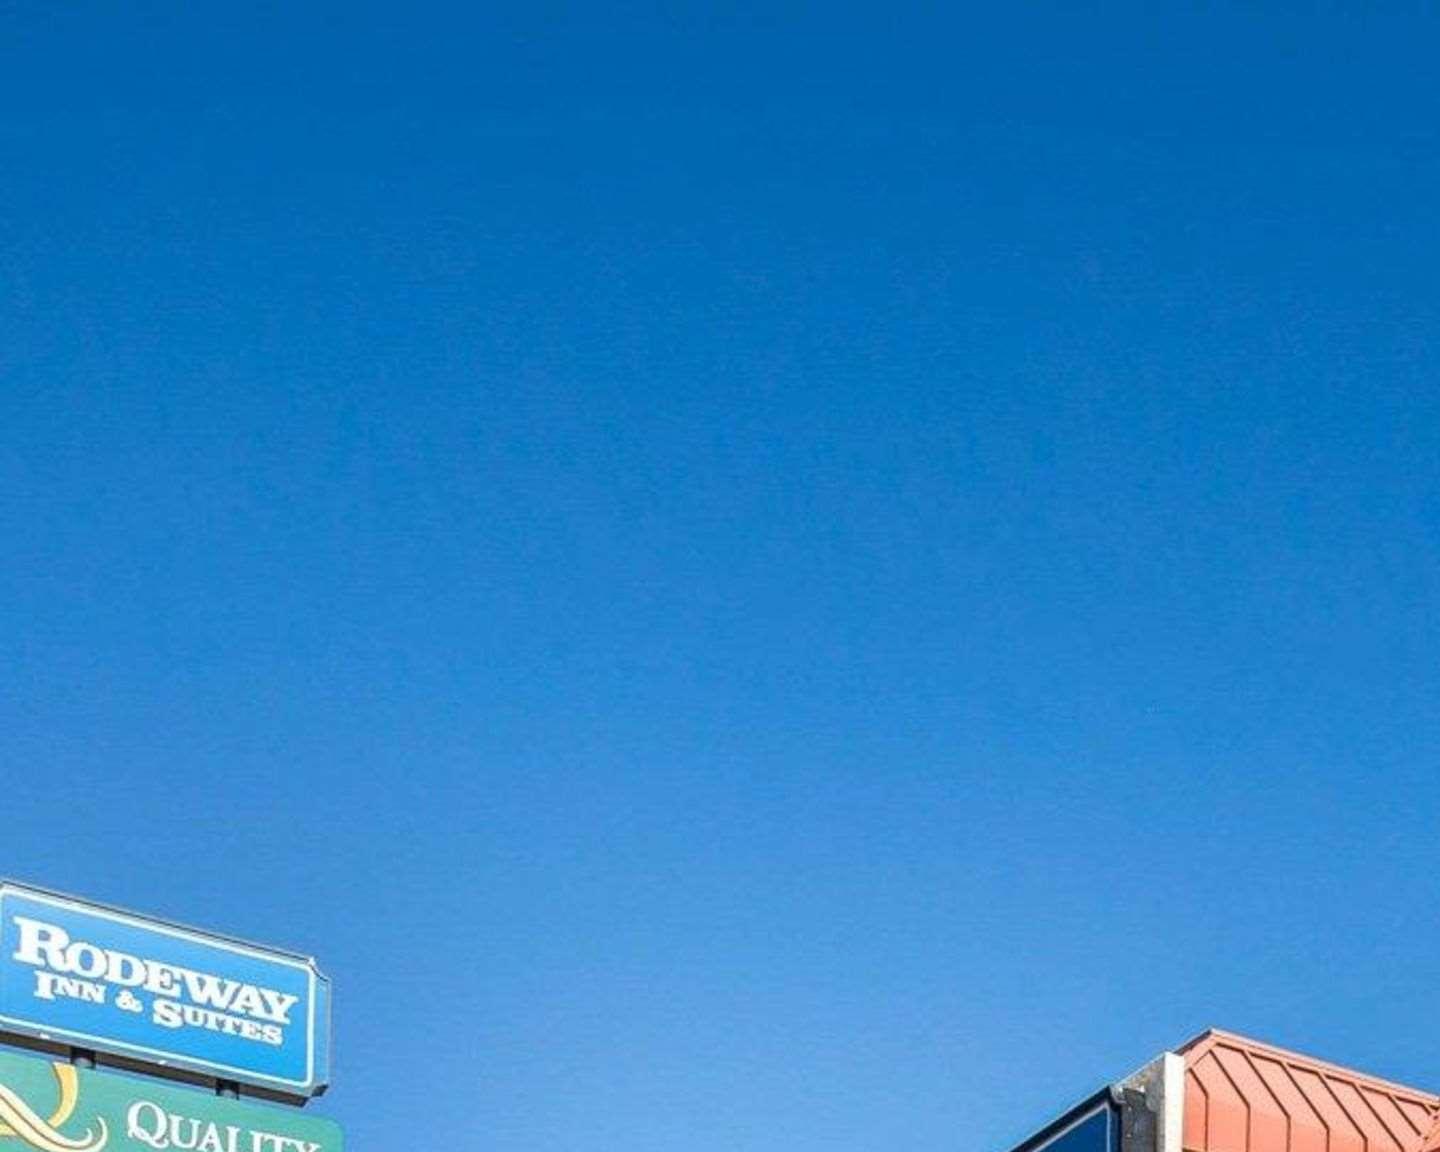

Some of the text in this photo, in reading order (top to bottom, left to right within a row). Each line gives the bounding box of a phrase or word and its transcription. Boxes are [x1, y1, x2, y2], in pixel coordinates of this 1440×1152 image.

[13, 916, 298, 1025] RODEWAY
[34, 970, 283, 1046] INN & SUITES
